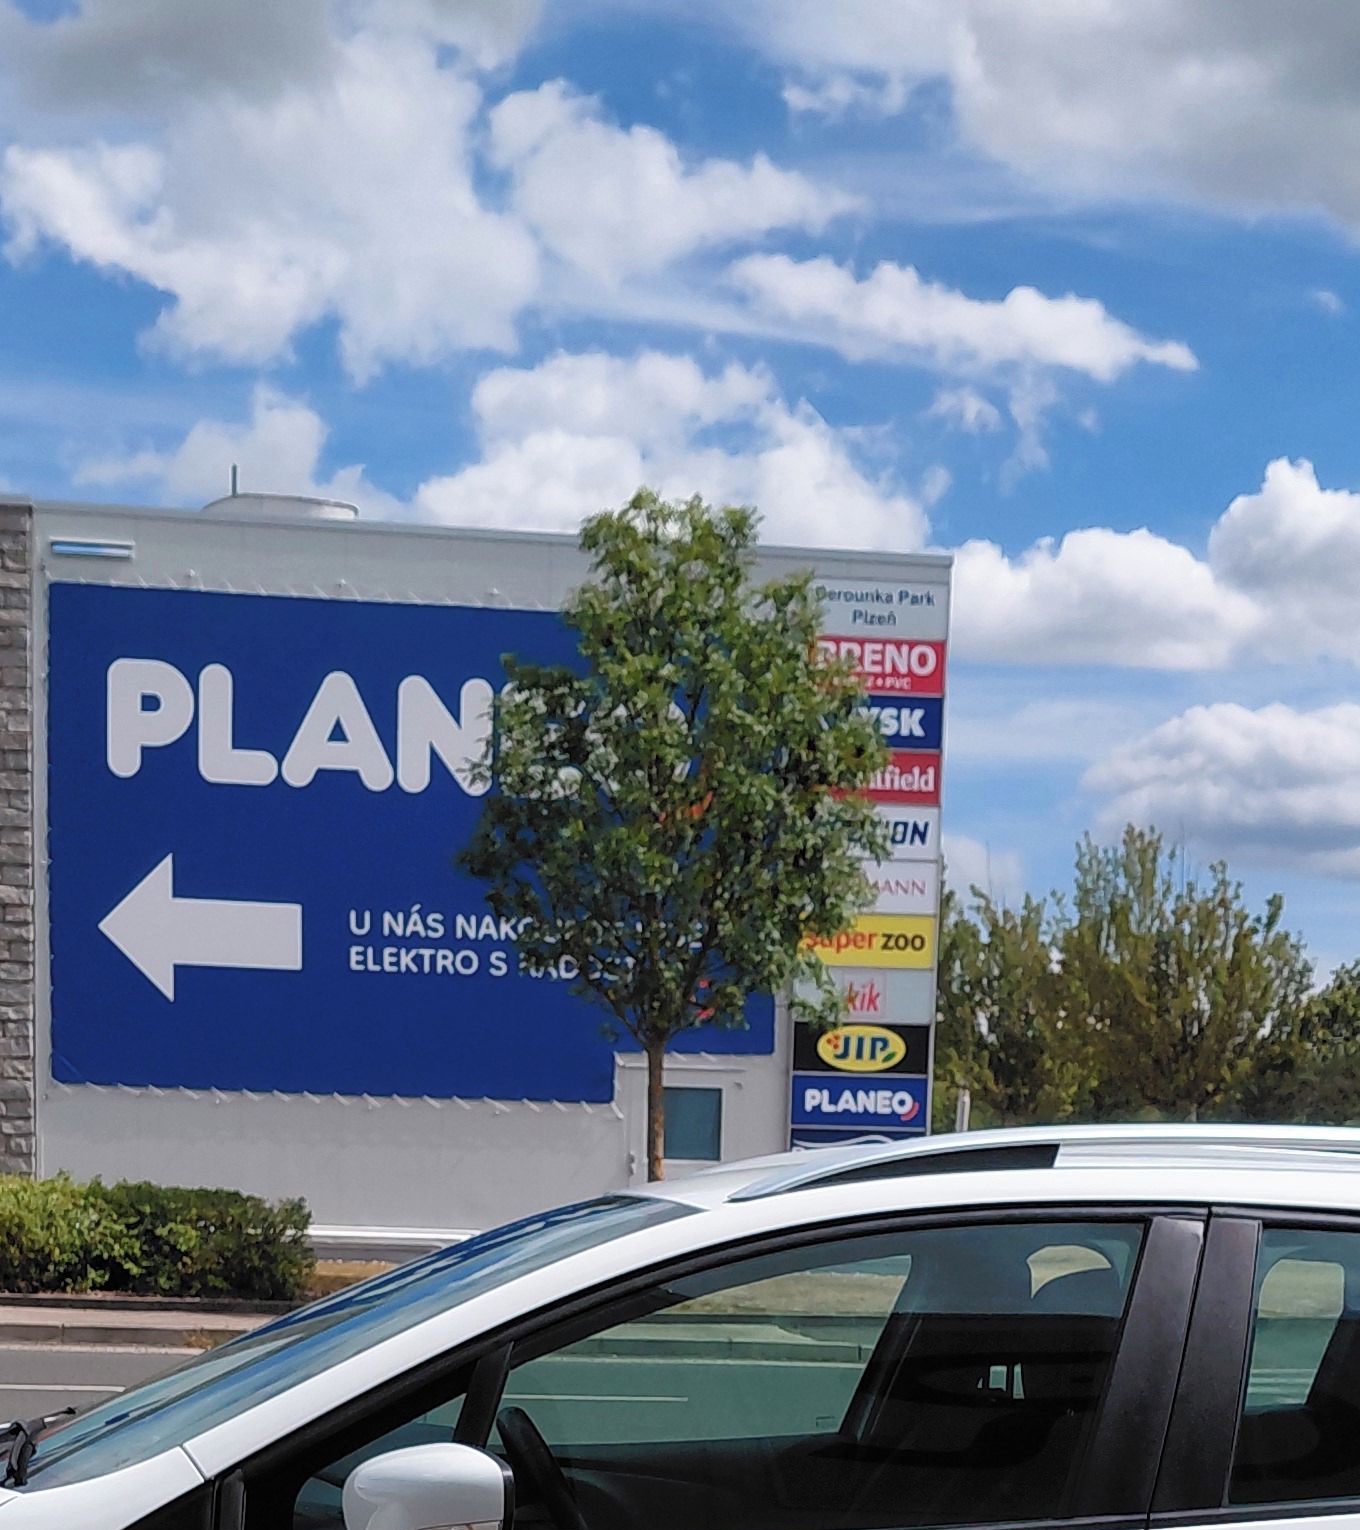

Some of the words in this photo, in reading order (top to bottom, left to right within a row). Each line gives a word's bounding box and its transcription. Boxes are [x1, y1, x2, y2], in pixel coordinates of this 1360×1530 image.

[898, 590, 935, 606] Park
[106, 657, 690, 800] PLAN
[857, 706, 925, 737] YSK
[348, 909, 371, 937] U
[382, 903, 446, 939] NÁS
[348, 945, 480, 977] ELEKTRO
[488, 950, 508, 978] S
[833, 1035, 889, 1060] JIP
[804, 1087, 914, 1115] PLANEO
